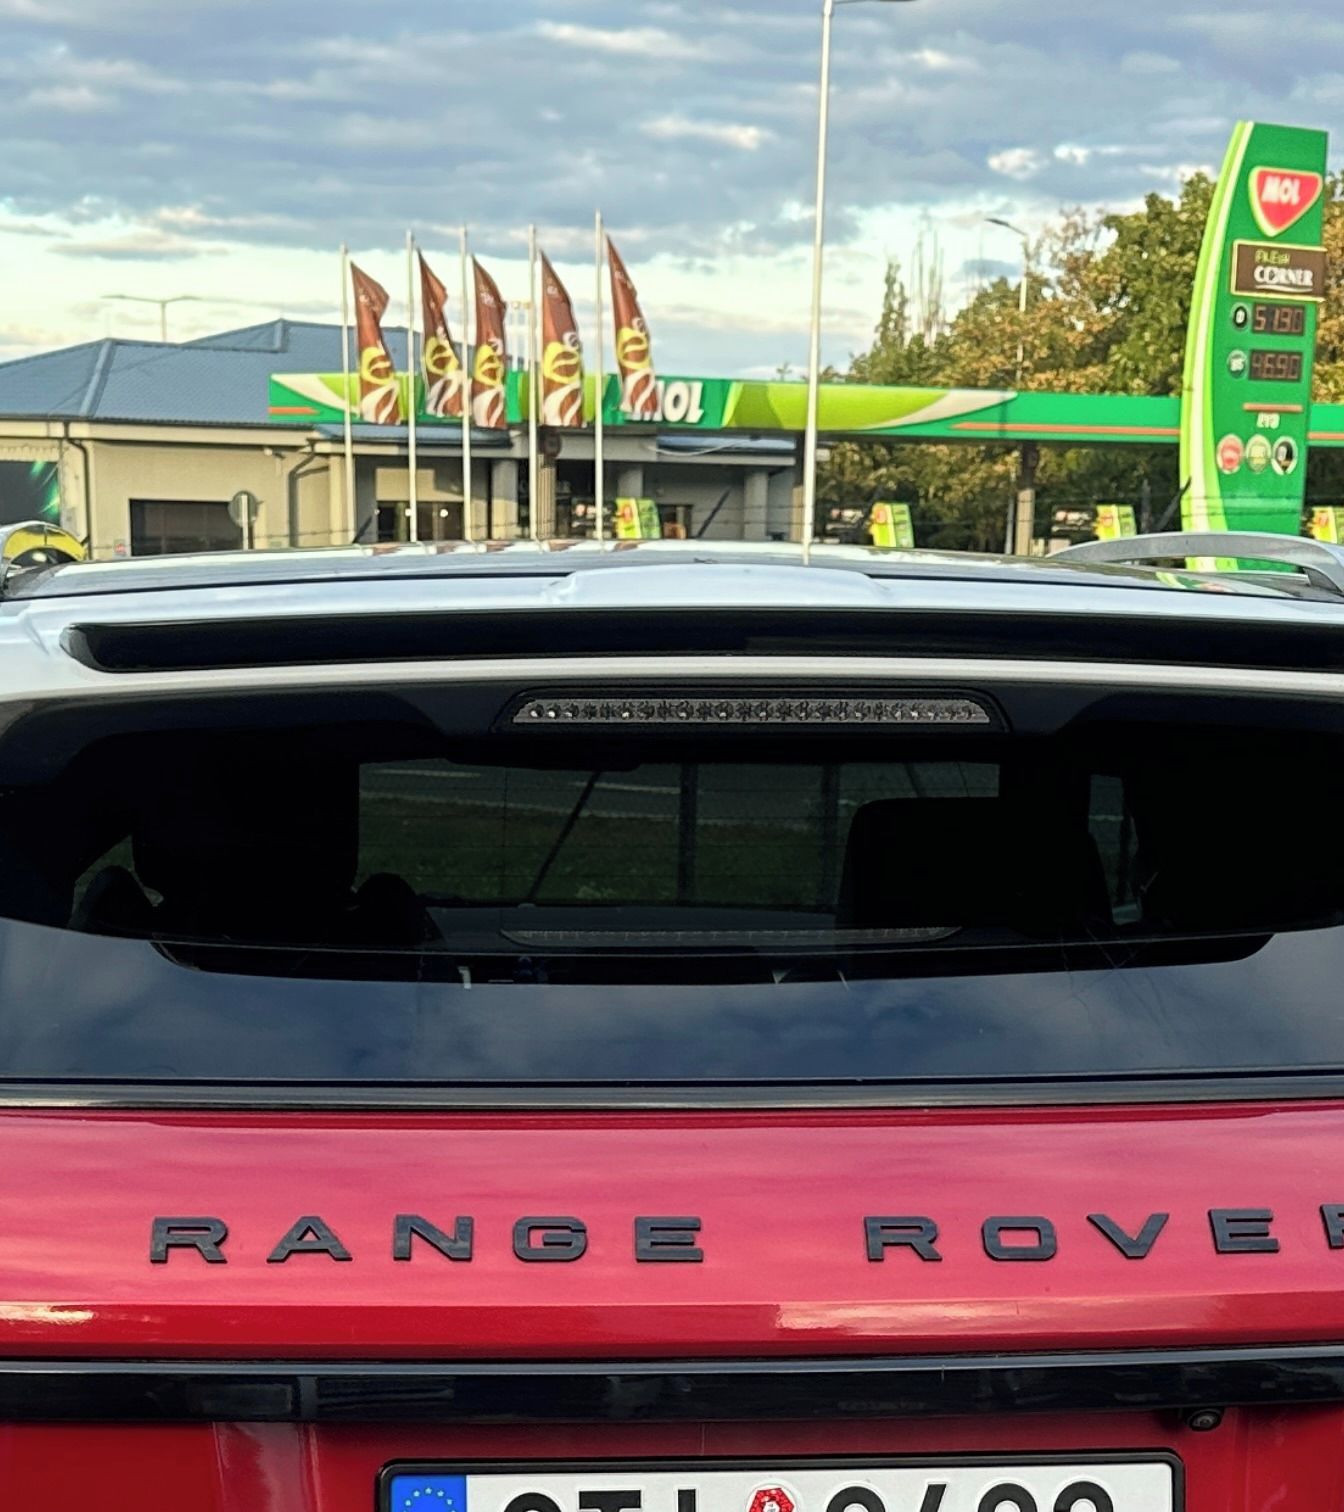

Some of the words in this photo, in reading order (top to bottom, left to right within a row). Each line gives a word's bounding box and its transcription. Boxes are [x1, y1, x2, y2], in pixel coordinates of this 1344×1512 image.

[1261, 175, 1300, 205] MOL
[1253, 265, 1314, 287] CORNER
[150, 1214, 706, 1266] RANGE
